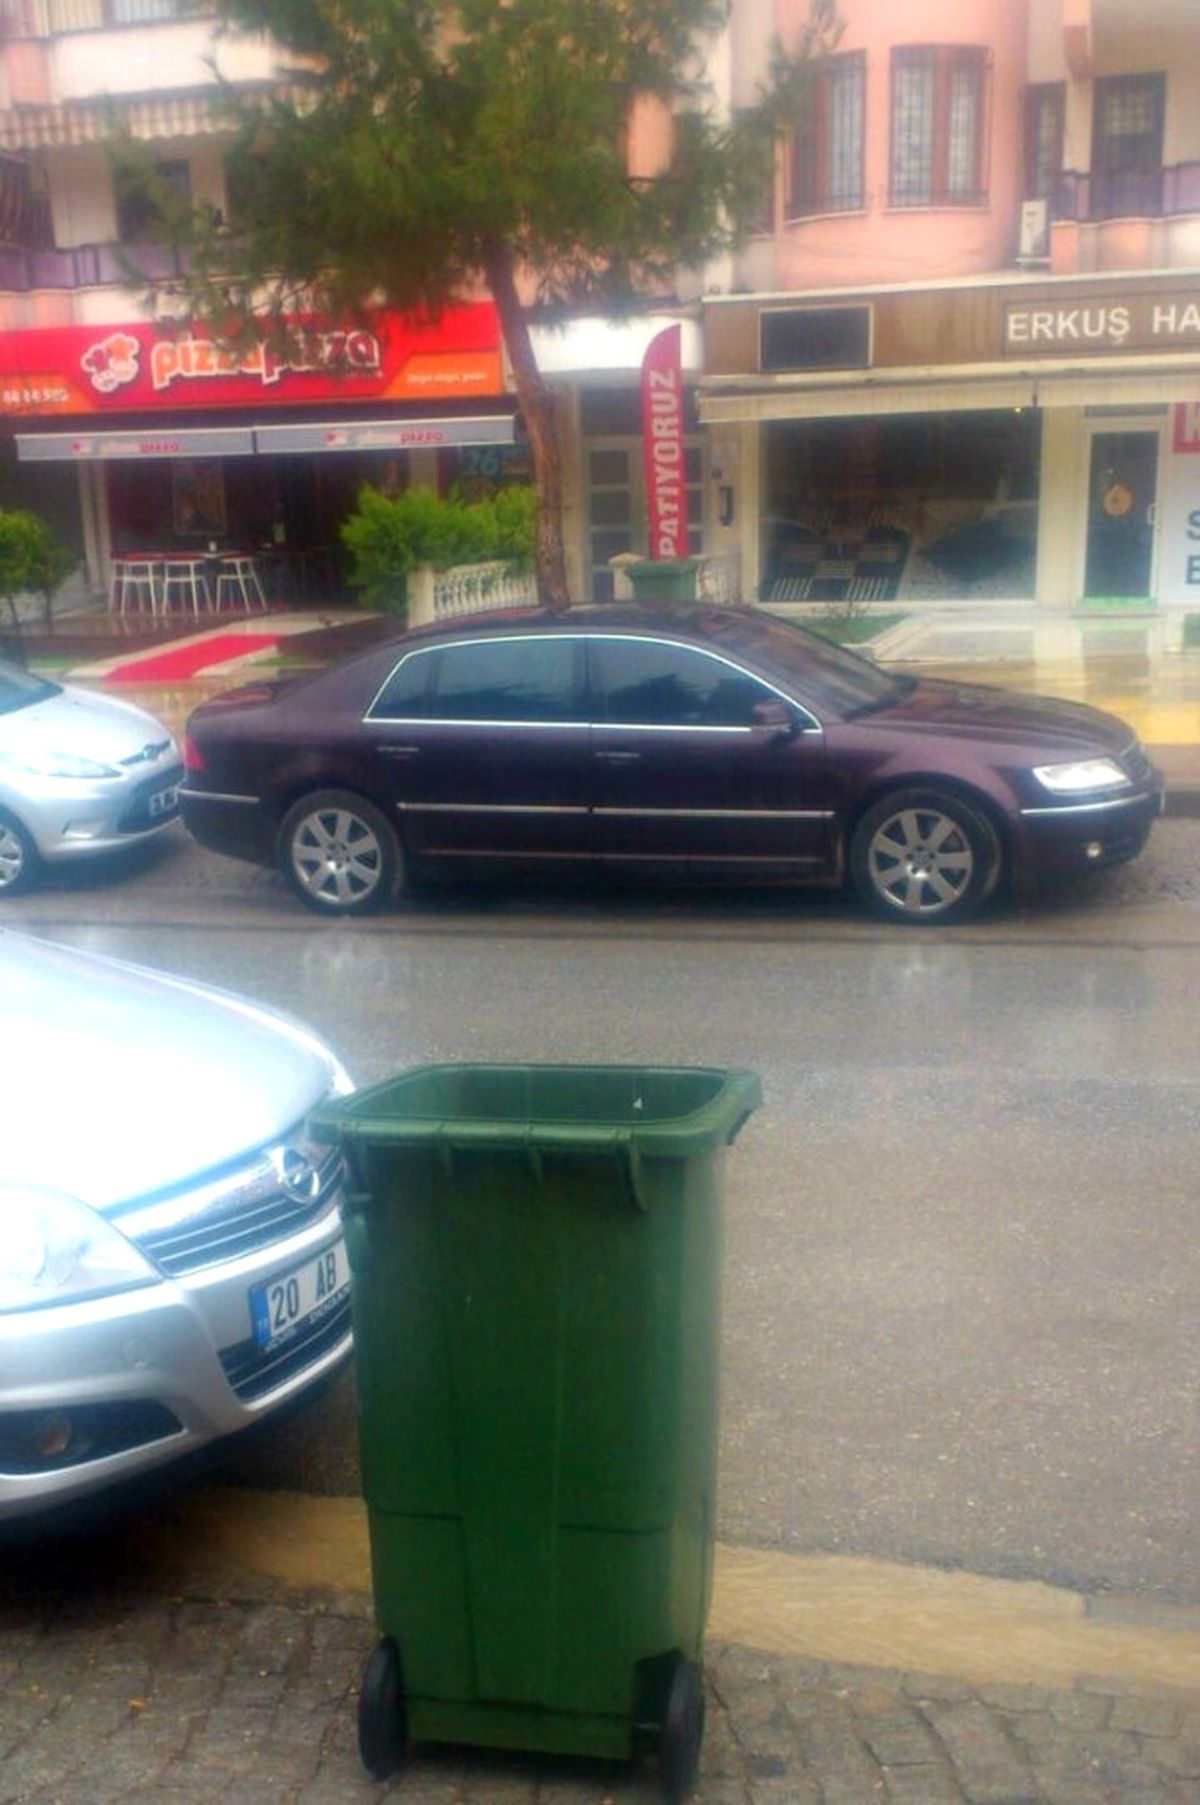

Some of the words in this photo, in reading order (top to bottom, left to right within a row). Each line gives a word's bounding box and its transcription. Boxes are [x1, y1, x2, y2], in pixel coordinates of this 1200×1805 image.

[1007, 307, 1131, 345] ERKUŞ
[1152, 303, 1200, 333] HA
[650, 369, 679, 557] PATIYORUZ
[271, 1278, 299, 1328] 20
[316, 1252, 336, 1301] AB
